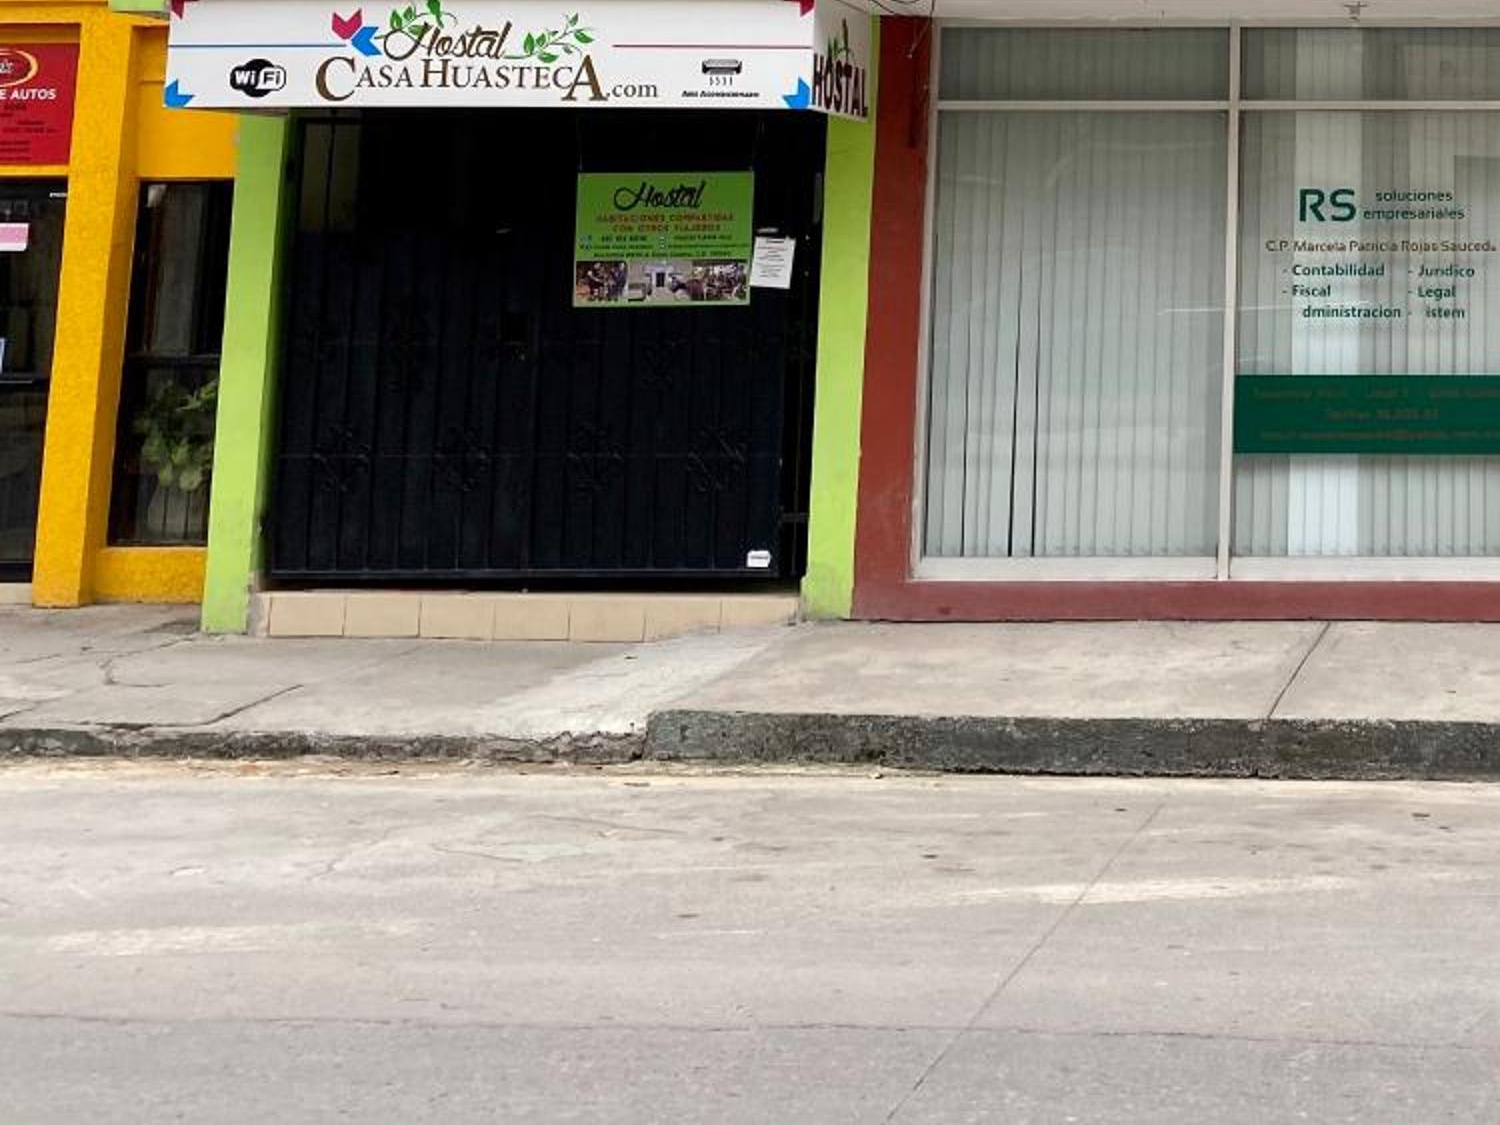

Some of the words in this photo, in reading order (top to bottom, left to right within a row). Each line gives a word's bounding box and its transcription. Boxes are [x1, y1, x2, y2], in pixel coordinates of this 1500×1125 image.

[382, 20, 513, 62] Hostal
[811, 52, 869, 118] HOSTAL
[10, 88, 57, 100] AUTOS
[613, 180, 707, 212] Hostal
[1375, 189, 1453, 202] soluciones
[1298, 188, 1357, 222] RS
[1362, 206, 1466, 220] empresariales
[1291, 263, 1385, 277] Contabilidad
[1291, 284, 1332, 297] Fiscal
[1417, 285, 1457, 301] Legal
